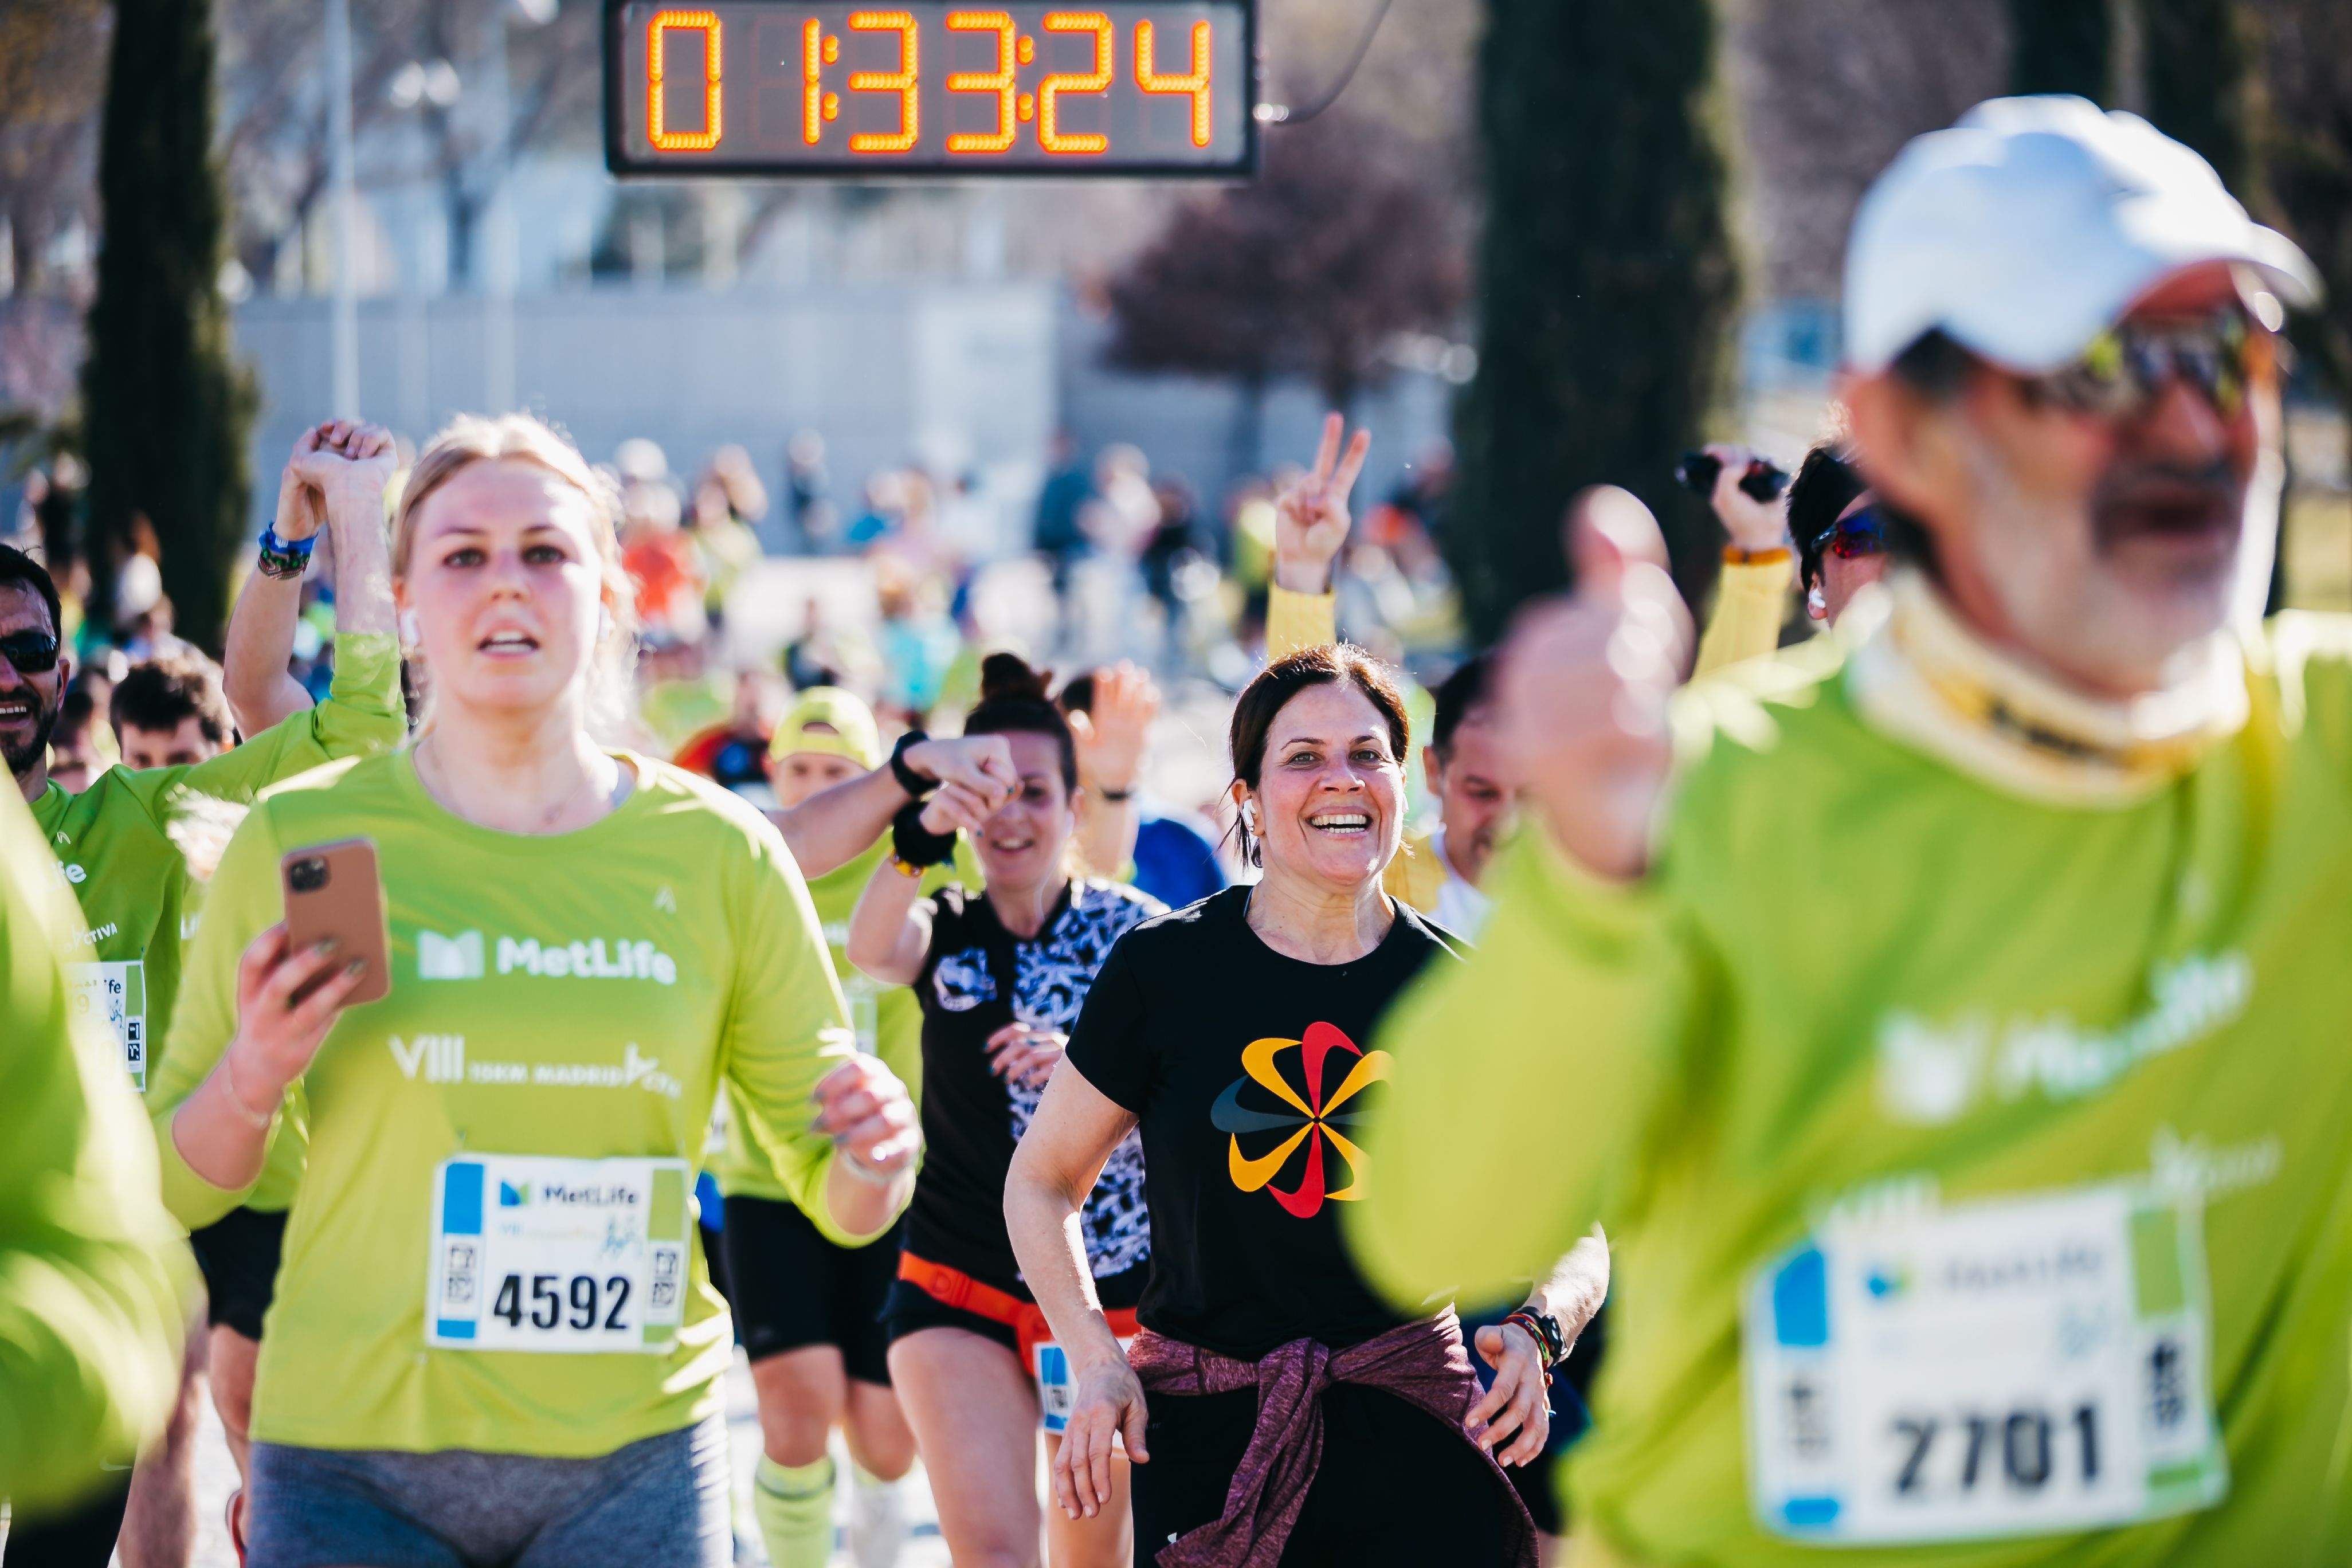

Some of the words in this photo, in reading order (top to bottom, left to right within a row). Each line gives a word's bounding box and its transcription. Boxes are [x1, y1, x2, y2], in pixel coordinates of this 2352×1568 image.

[496, 935, 677, 985] MetLife
[389, 1034, 464, 1084] VIII
[494, 1274, 632, 1331] 4592
[1891, 1404, 2102, 1493] 2701
